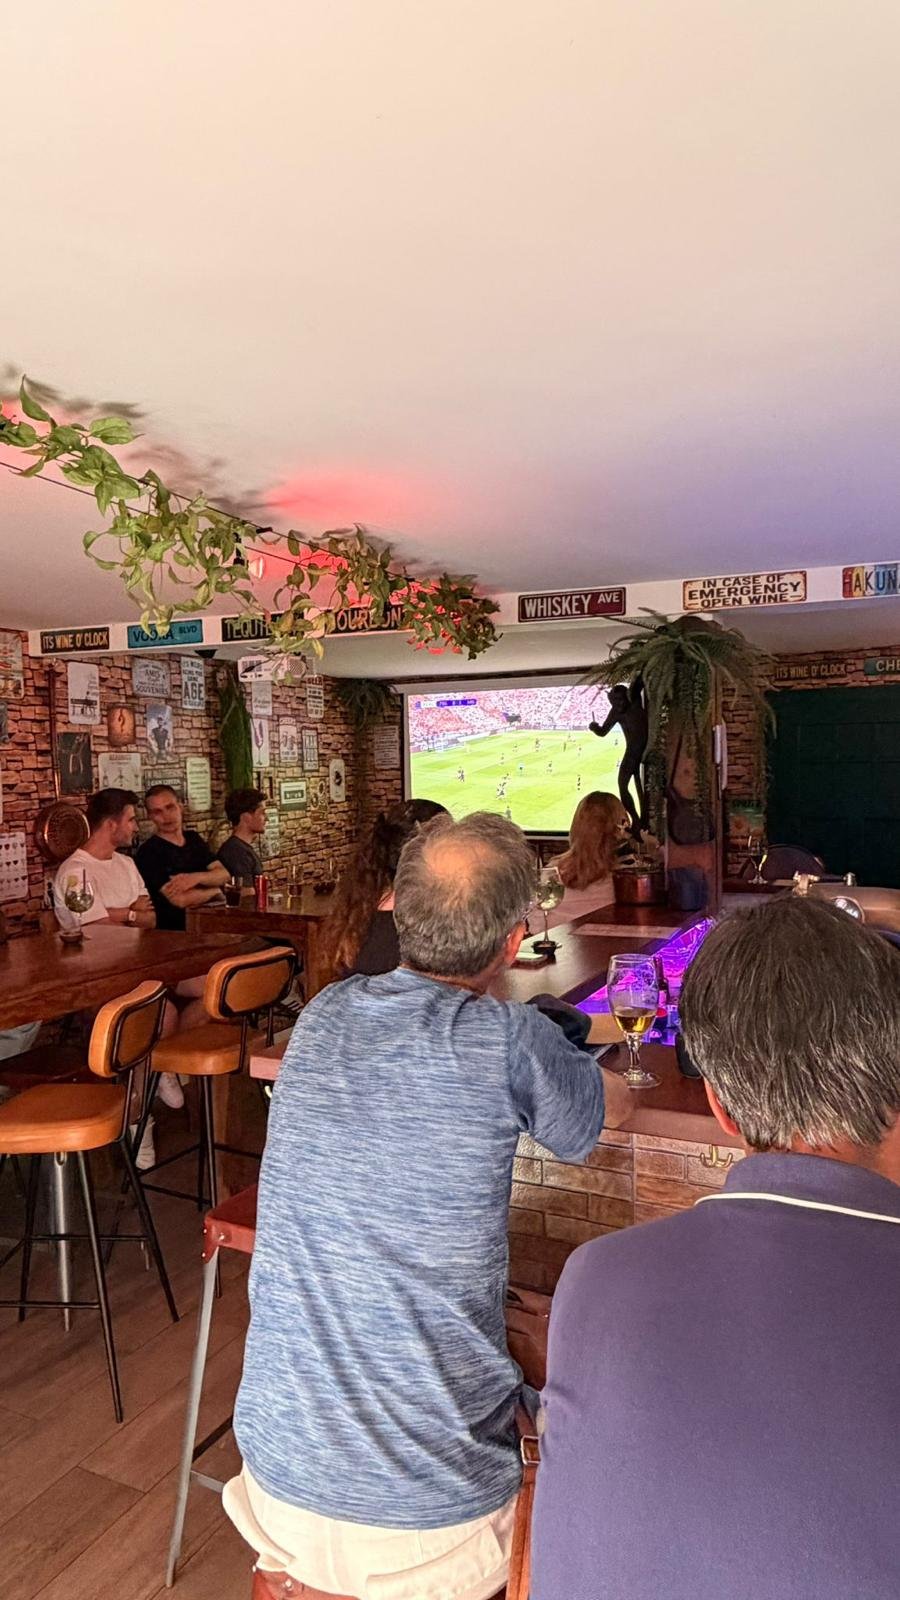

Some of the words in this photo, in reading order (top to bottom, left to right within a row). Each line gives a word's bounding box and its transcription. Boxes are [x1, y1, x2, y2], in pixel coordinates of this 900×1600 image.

[702, 580, 717, 589] IN
[722, 576, 761, 588] CASE
[766, 575, 785, 584] OF
[843, 570, 900, 593] HAKUN
[688, 581, 801, 601] EMERGENCY
[524, 594, 592, 618] WHISKEY
[597, 592, 620, 604] AVE
[700, 597, 743, 609] OPEN
[747, 593, 789, 605] WINE
[178, 625, 198, 635] BLVD
[55, 633, 74, 649] WINE
[789, 665, 809, 678] WINE
[183, 681, 204, 701] AGE
